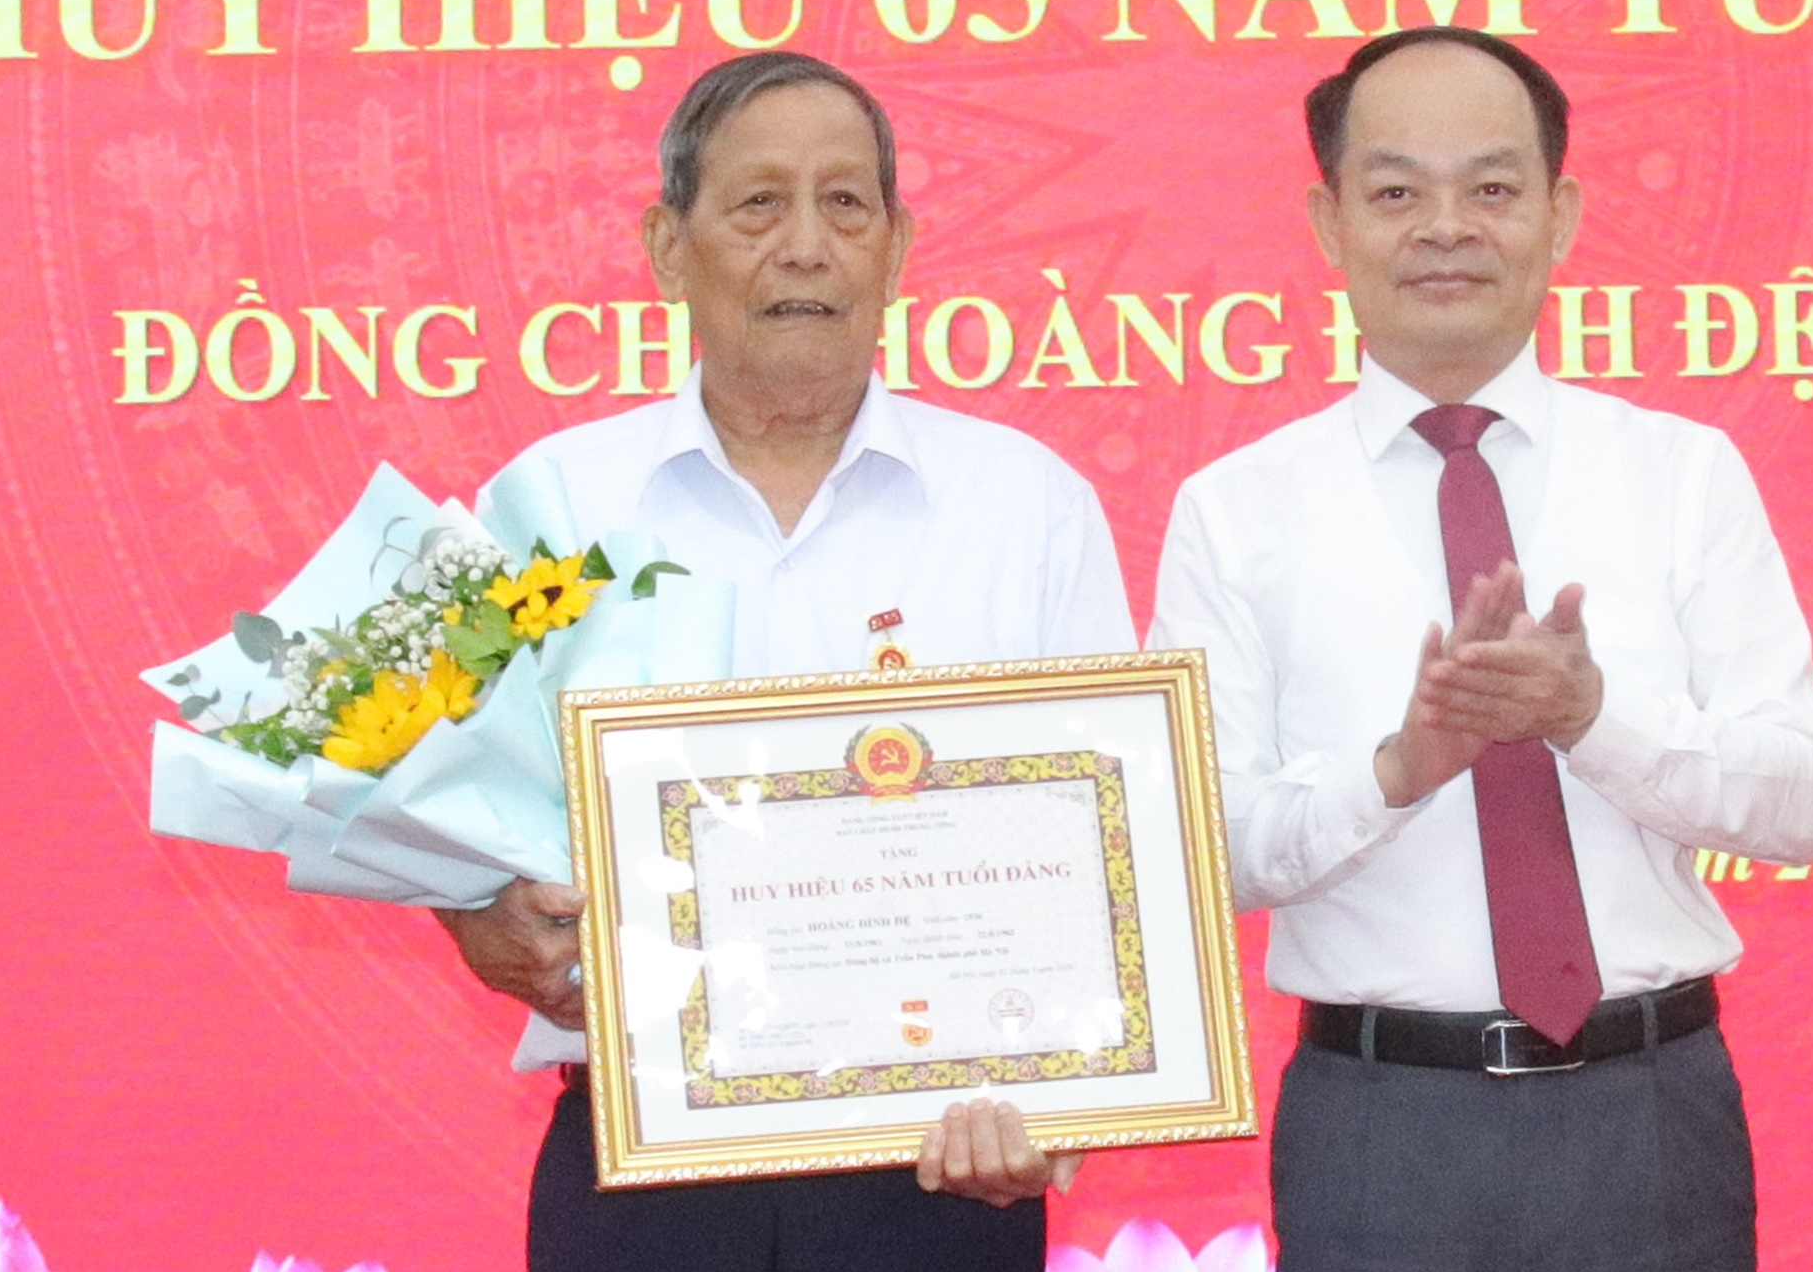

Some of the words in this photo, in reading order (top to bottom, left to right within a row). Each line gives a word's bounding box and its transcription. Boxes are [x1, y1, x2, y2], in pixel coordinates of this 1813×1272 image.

[111, 278, 488, 404] ĐỒNG
[518, 300, 691, 396] CH
[731, 883, 781, 902] HUY
[788, 877, 845, 902] HIỆU
[852, 876, 874, 894] 65
[881, 870, 934, 891] NĂM
[942, 860, 1000, 887] TUỔI
[1006, 861, 1072, 883] ĐẢNG
